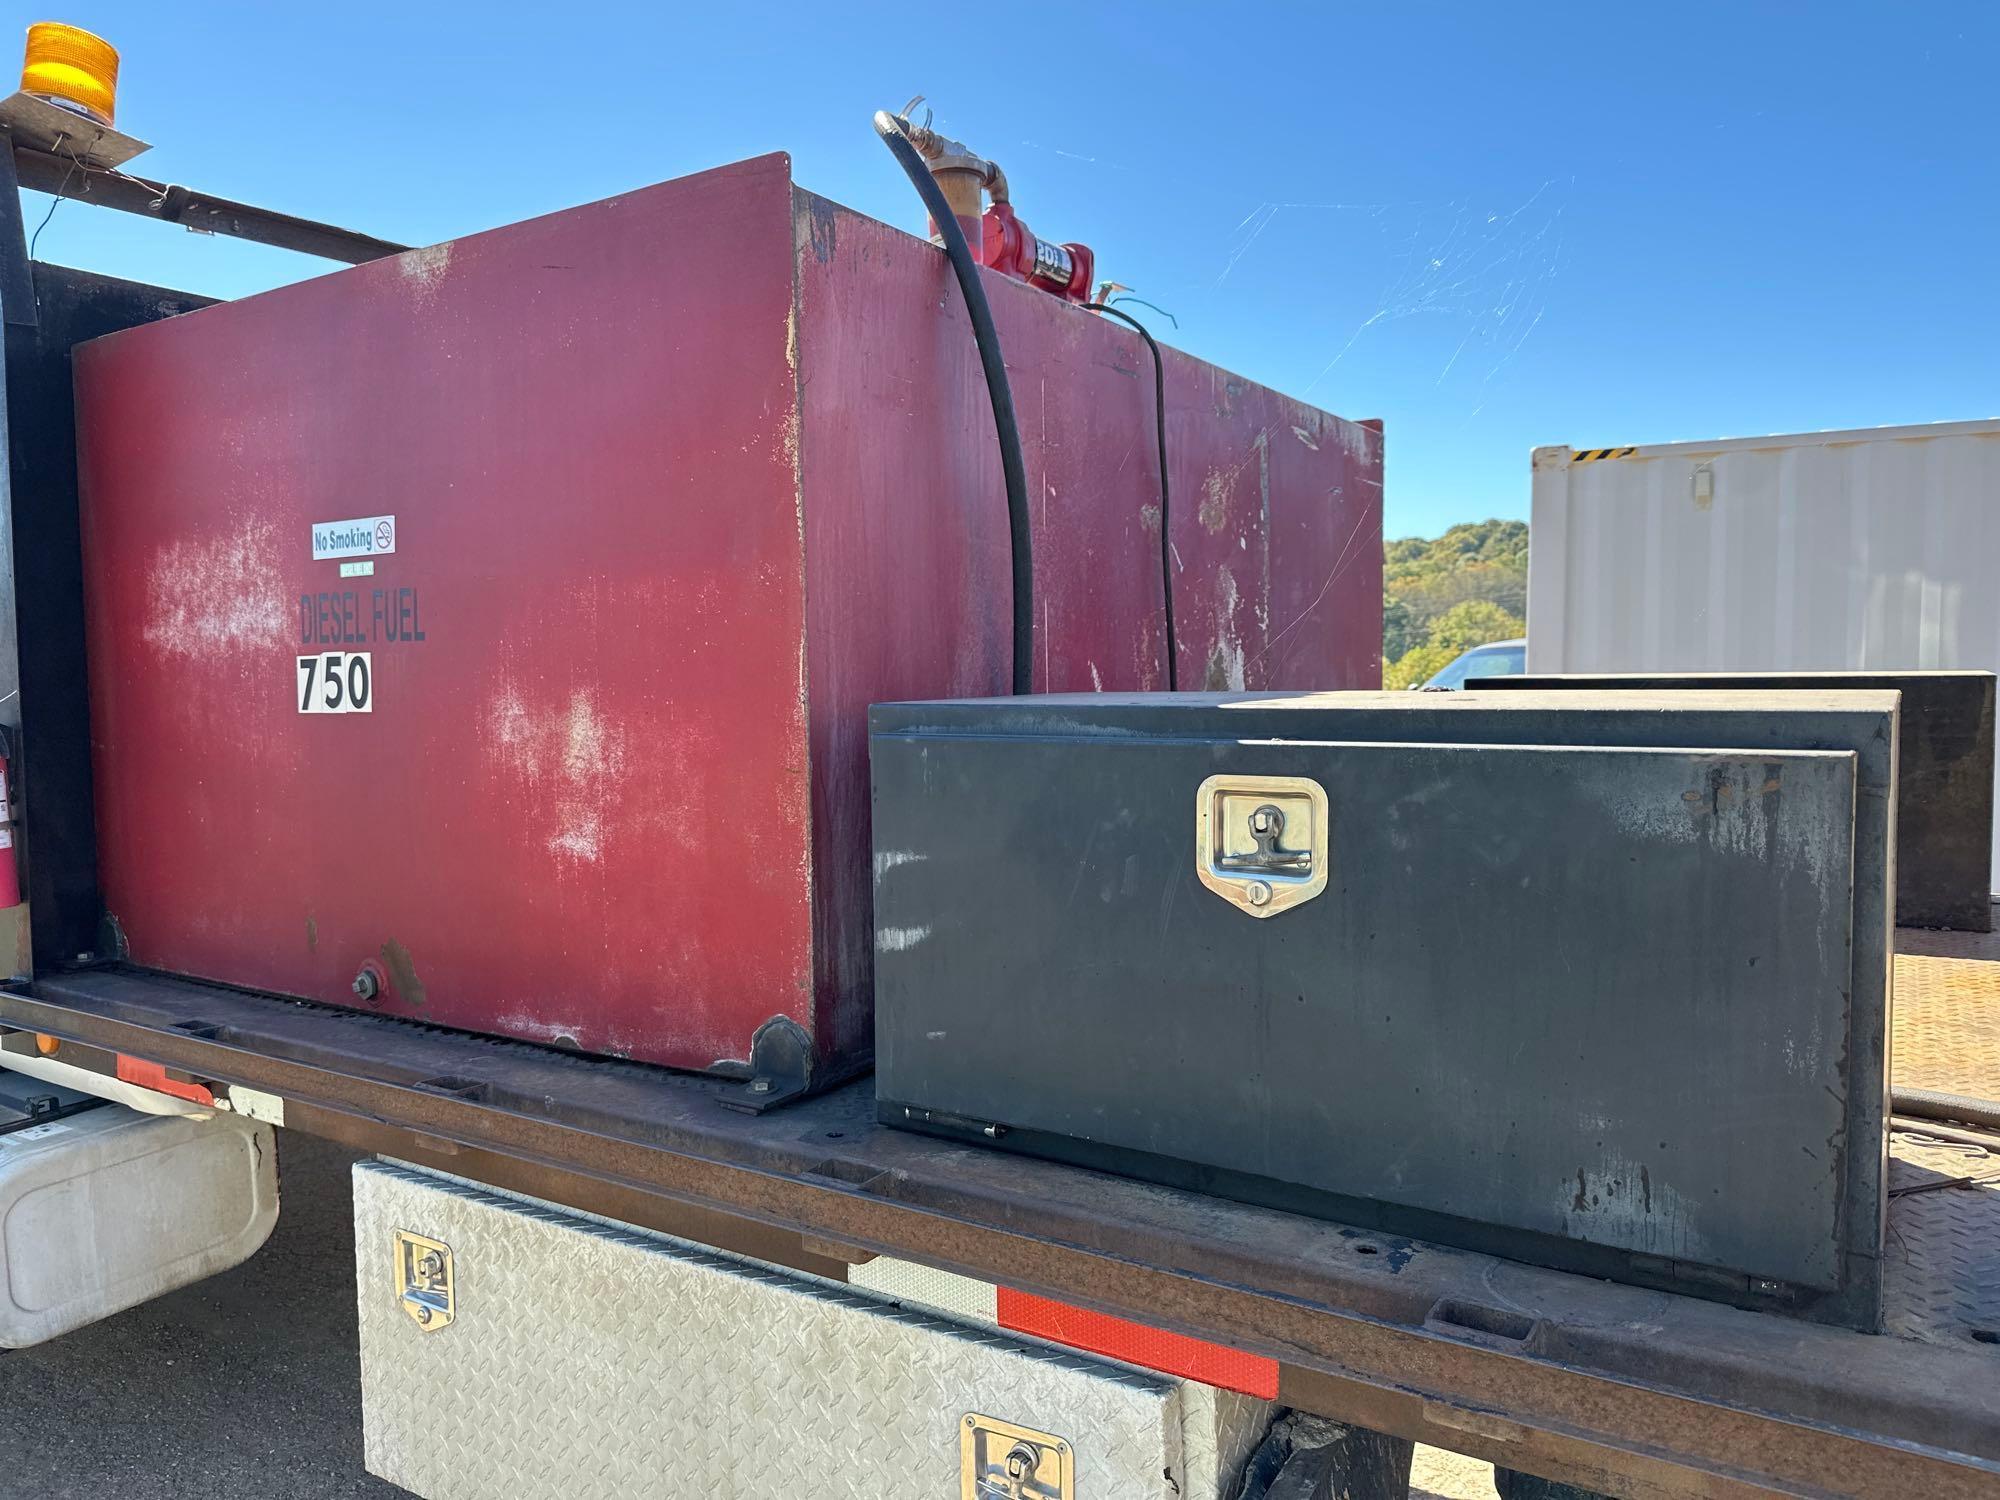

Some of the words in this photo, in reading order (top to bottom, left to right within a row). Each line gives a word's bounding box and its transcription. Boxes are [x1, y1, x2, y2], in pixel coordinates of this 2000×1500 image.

[315, 532, 328, 551] No
[329, 528, 372, 551] Smoking
[301, 592, 367, 644] DIESEL
[372, 588, 425, 643] FUEL
[300, 656, 368, 710] 750
